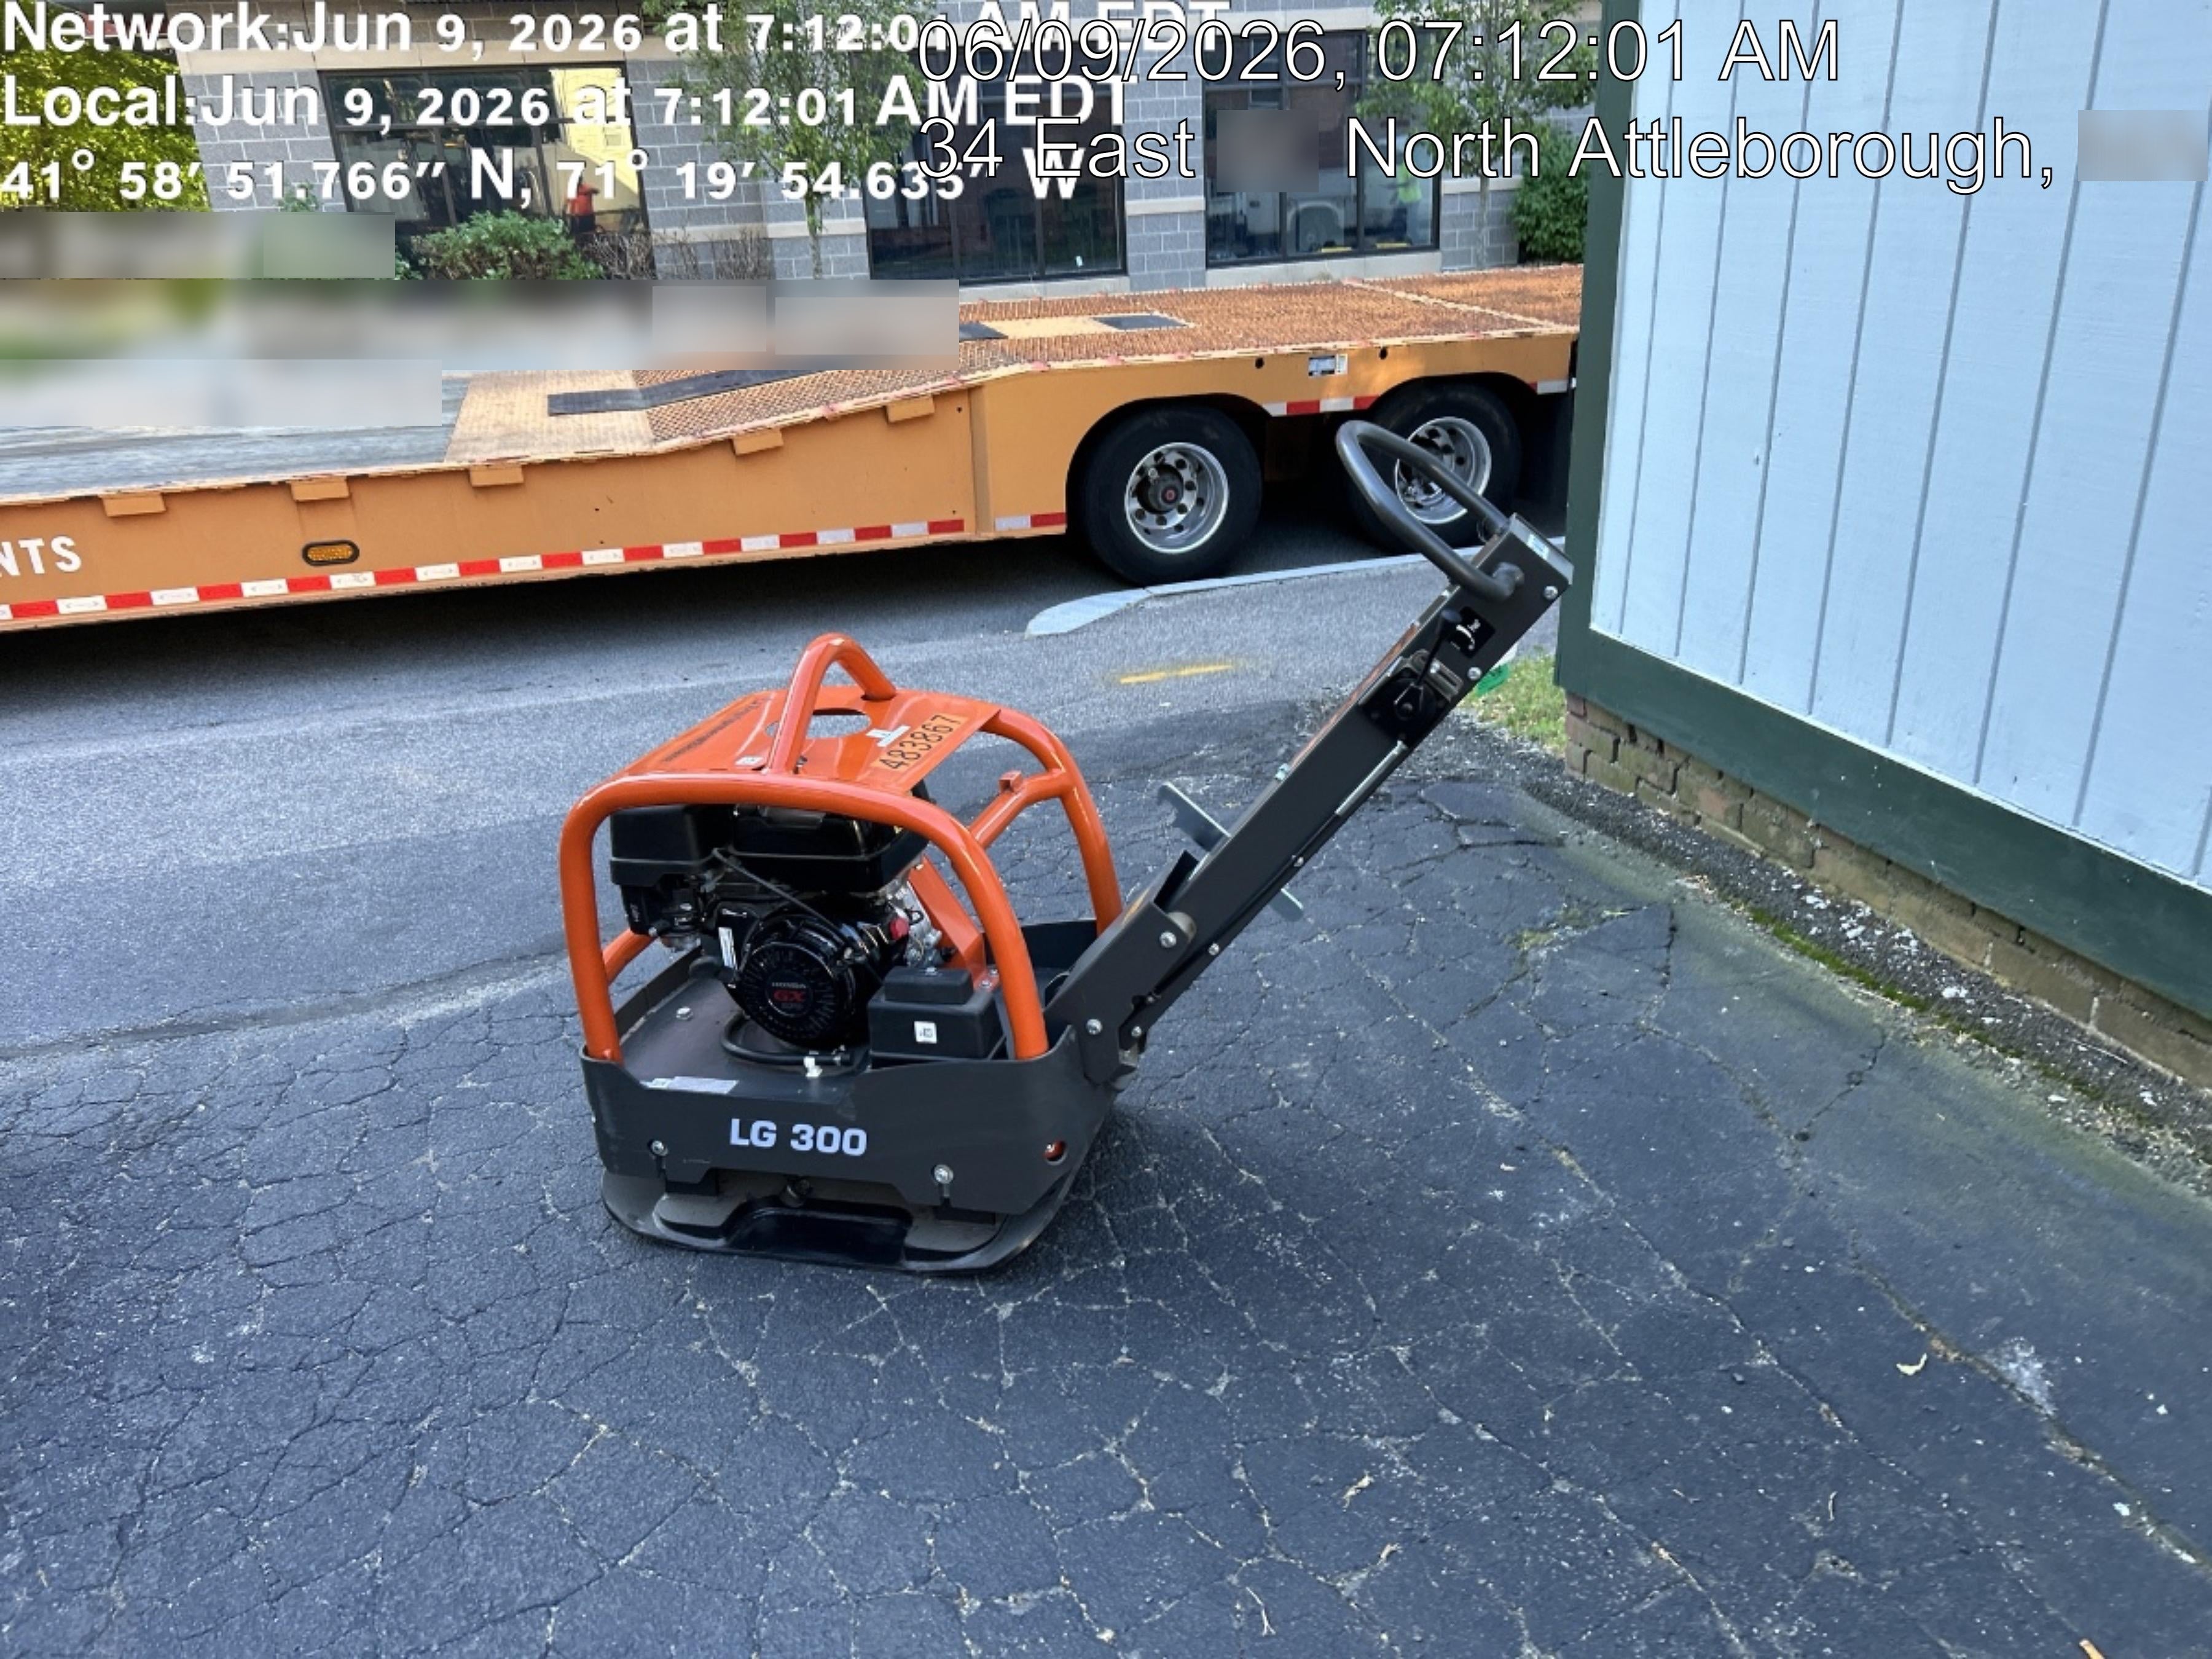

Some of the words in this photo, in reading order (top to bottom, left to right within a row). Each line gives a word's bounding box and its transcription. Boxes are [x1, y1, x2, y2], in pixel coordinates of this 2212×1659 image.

[879, 714, 961, 769] 483867
[729, 1118, 777, 1148] LG
[790, 1123, 868, 1156] 300
